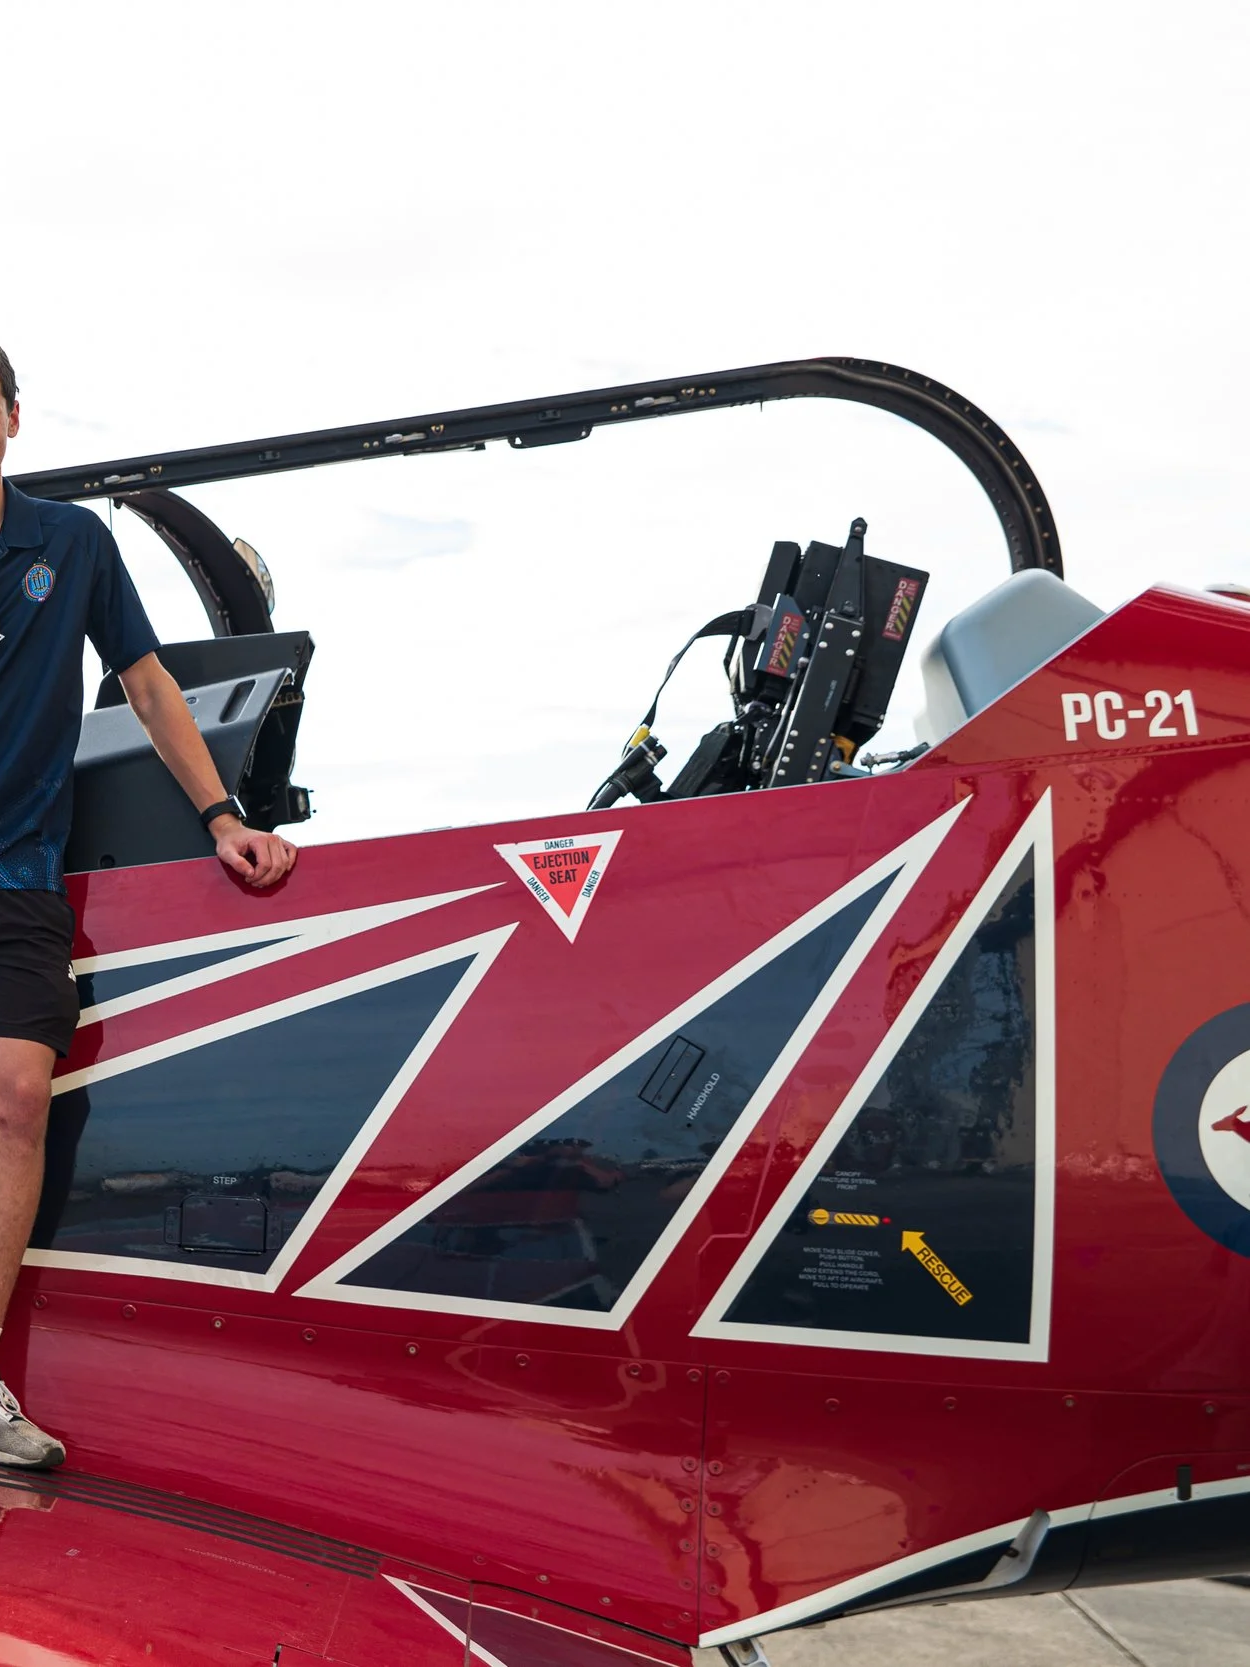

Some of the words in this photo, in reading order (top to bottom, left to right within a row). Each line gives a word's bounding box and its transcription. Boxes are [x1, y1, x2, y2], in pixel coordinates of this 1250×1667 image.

[885, 580, 907, 631] DANGER
[769, 615, 792, 668] DANGER
[1061, 689, 1199, 741] PC-21
[544, 839, 574, 850] DANGER
[533, 851, 590, 869] EJECTION
[527, 877, 550, 903] DANGER
[549, 869, 577, 885] SEAT
[582, 870, 600, 898] DANGER
[686, 1072, 720, 1120] HANDHOLD
[213, 1176, 237, 1185] STEP
[916, 1247, 970, 1303] RESCUE
